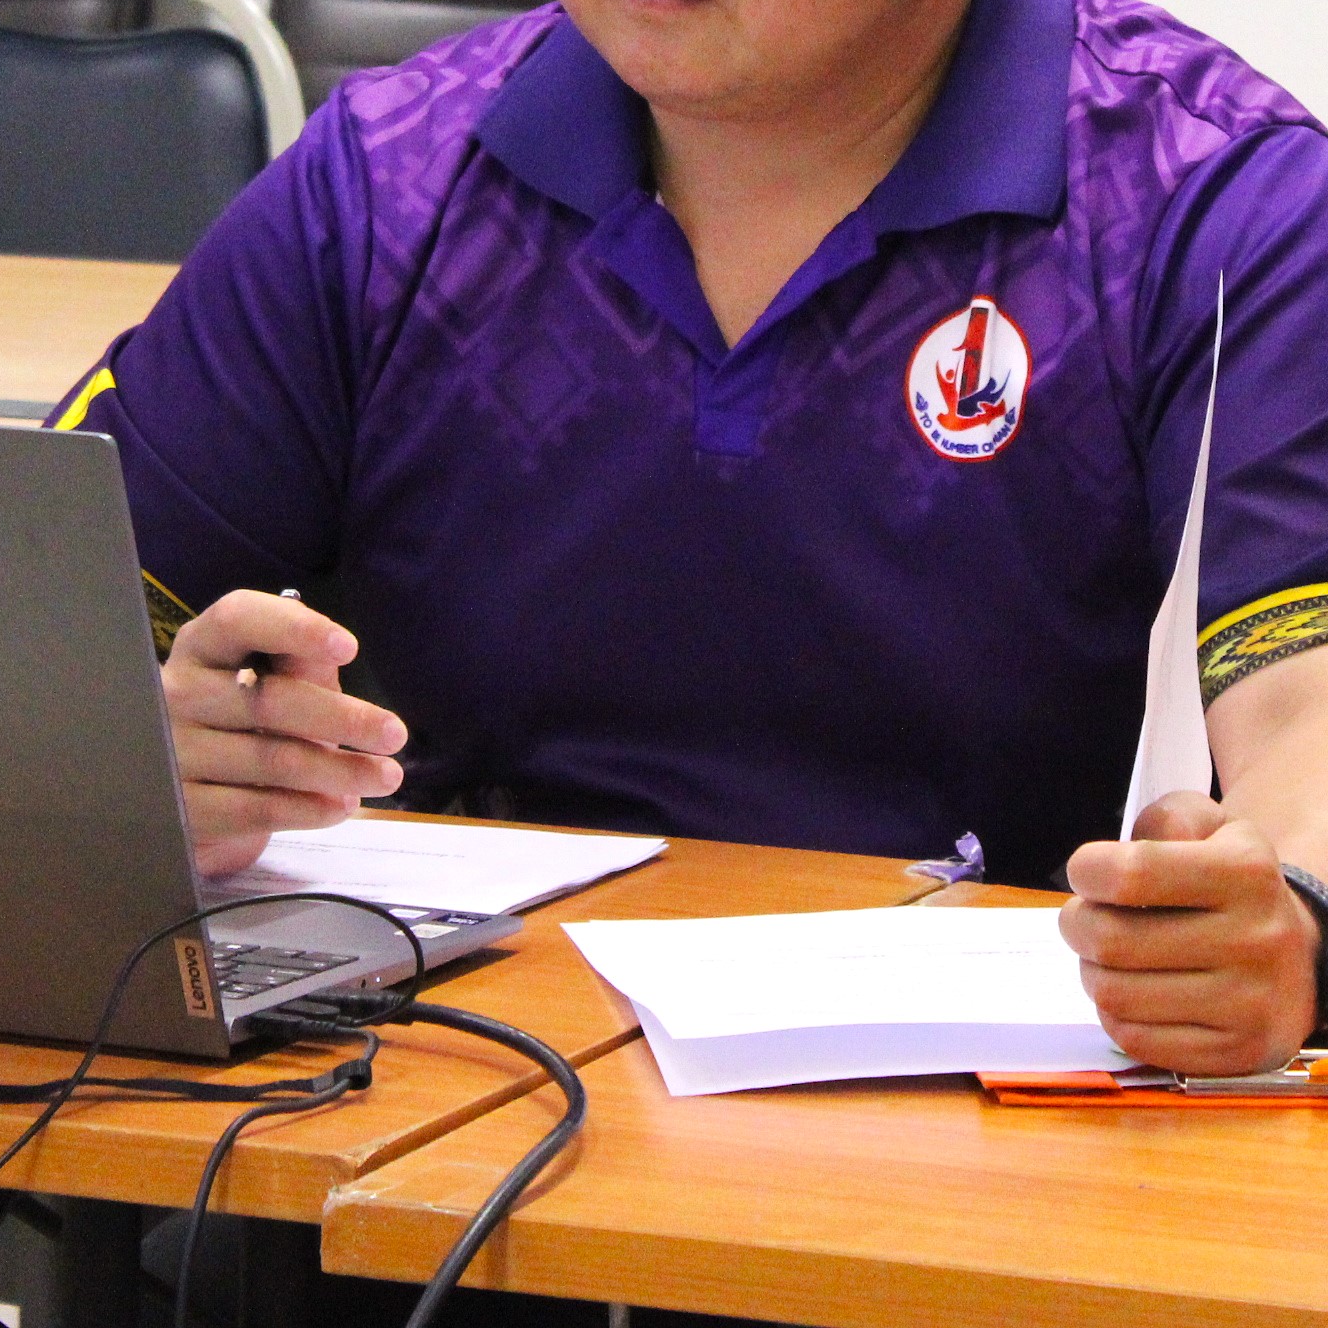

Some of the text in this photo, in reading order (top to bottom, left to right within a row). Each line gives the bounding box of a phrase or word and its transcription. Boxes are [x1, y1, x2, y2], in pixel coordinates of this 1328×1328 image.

[920, 412, 932, 428] TO
[941, 438, 979, 454] NUMBER
[184, 945, 208, 1011] Lenovo
